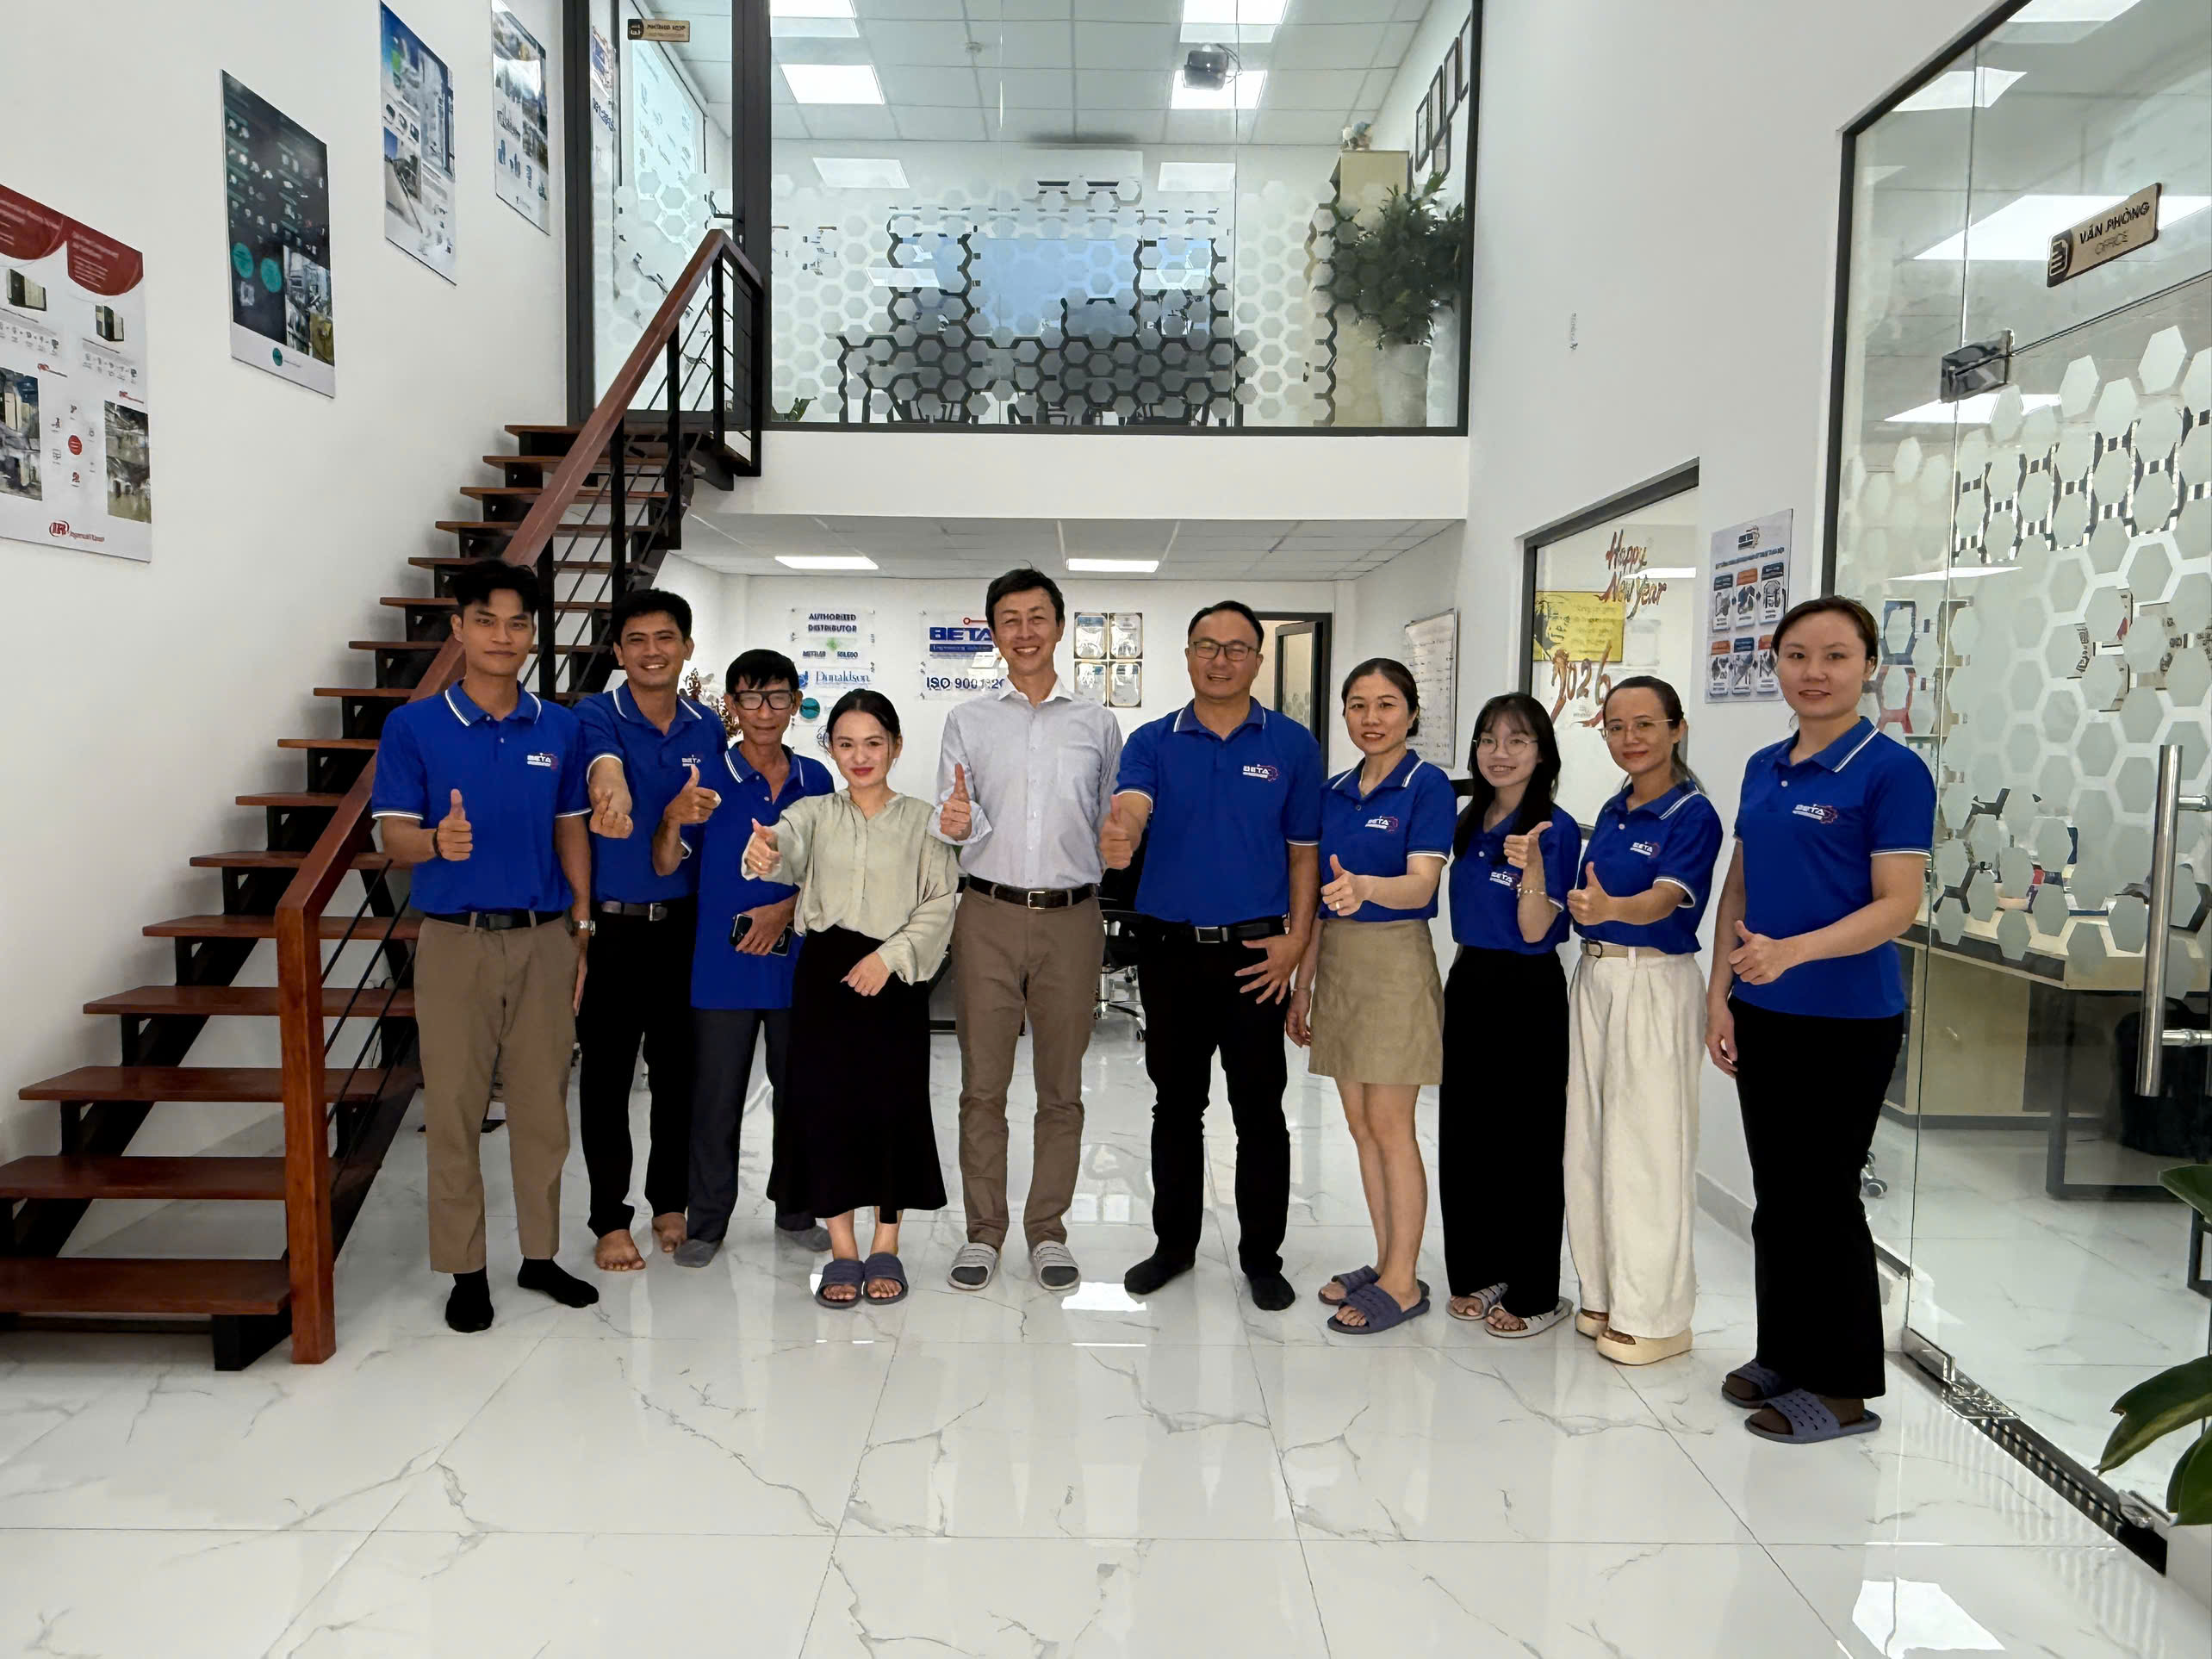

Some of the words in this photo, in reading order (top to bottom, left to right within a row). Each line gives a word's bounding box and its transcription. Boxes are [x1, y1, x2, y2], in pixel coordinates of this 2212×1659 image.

[2079, 223, 2103, 244] VĂN
[2105, 202, 2150, 233] PHÒNG
[1605, 528, 1647, 574] Happy
[1594, 571, 1635, 603] New
[808, 612, 857, 621] AUTHORIZED
[929, 626, 993, 642] BETA
[816, 670, 870, 683] Donaldson
[926, 676, 951, 689] ISO
[1243, 765, 1269, 774] BETA
